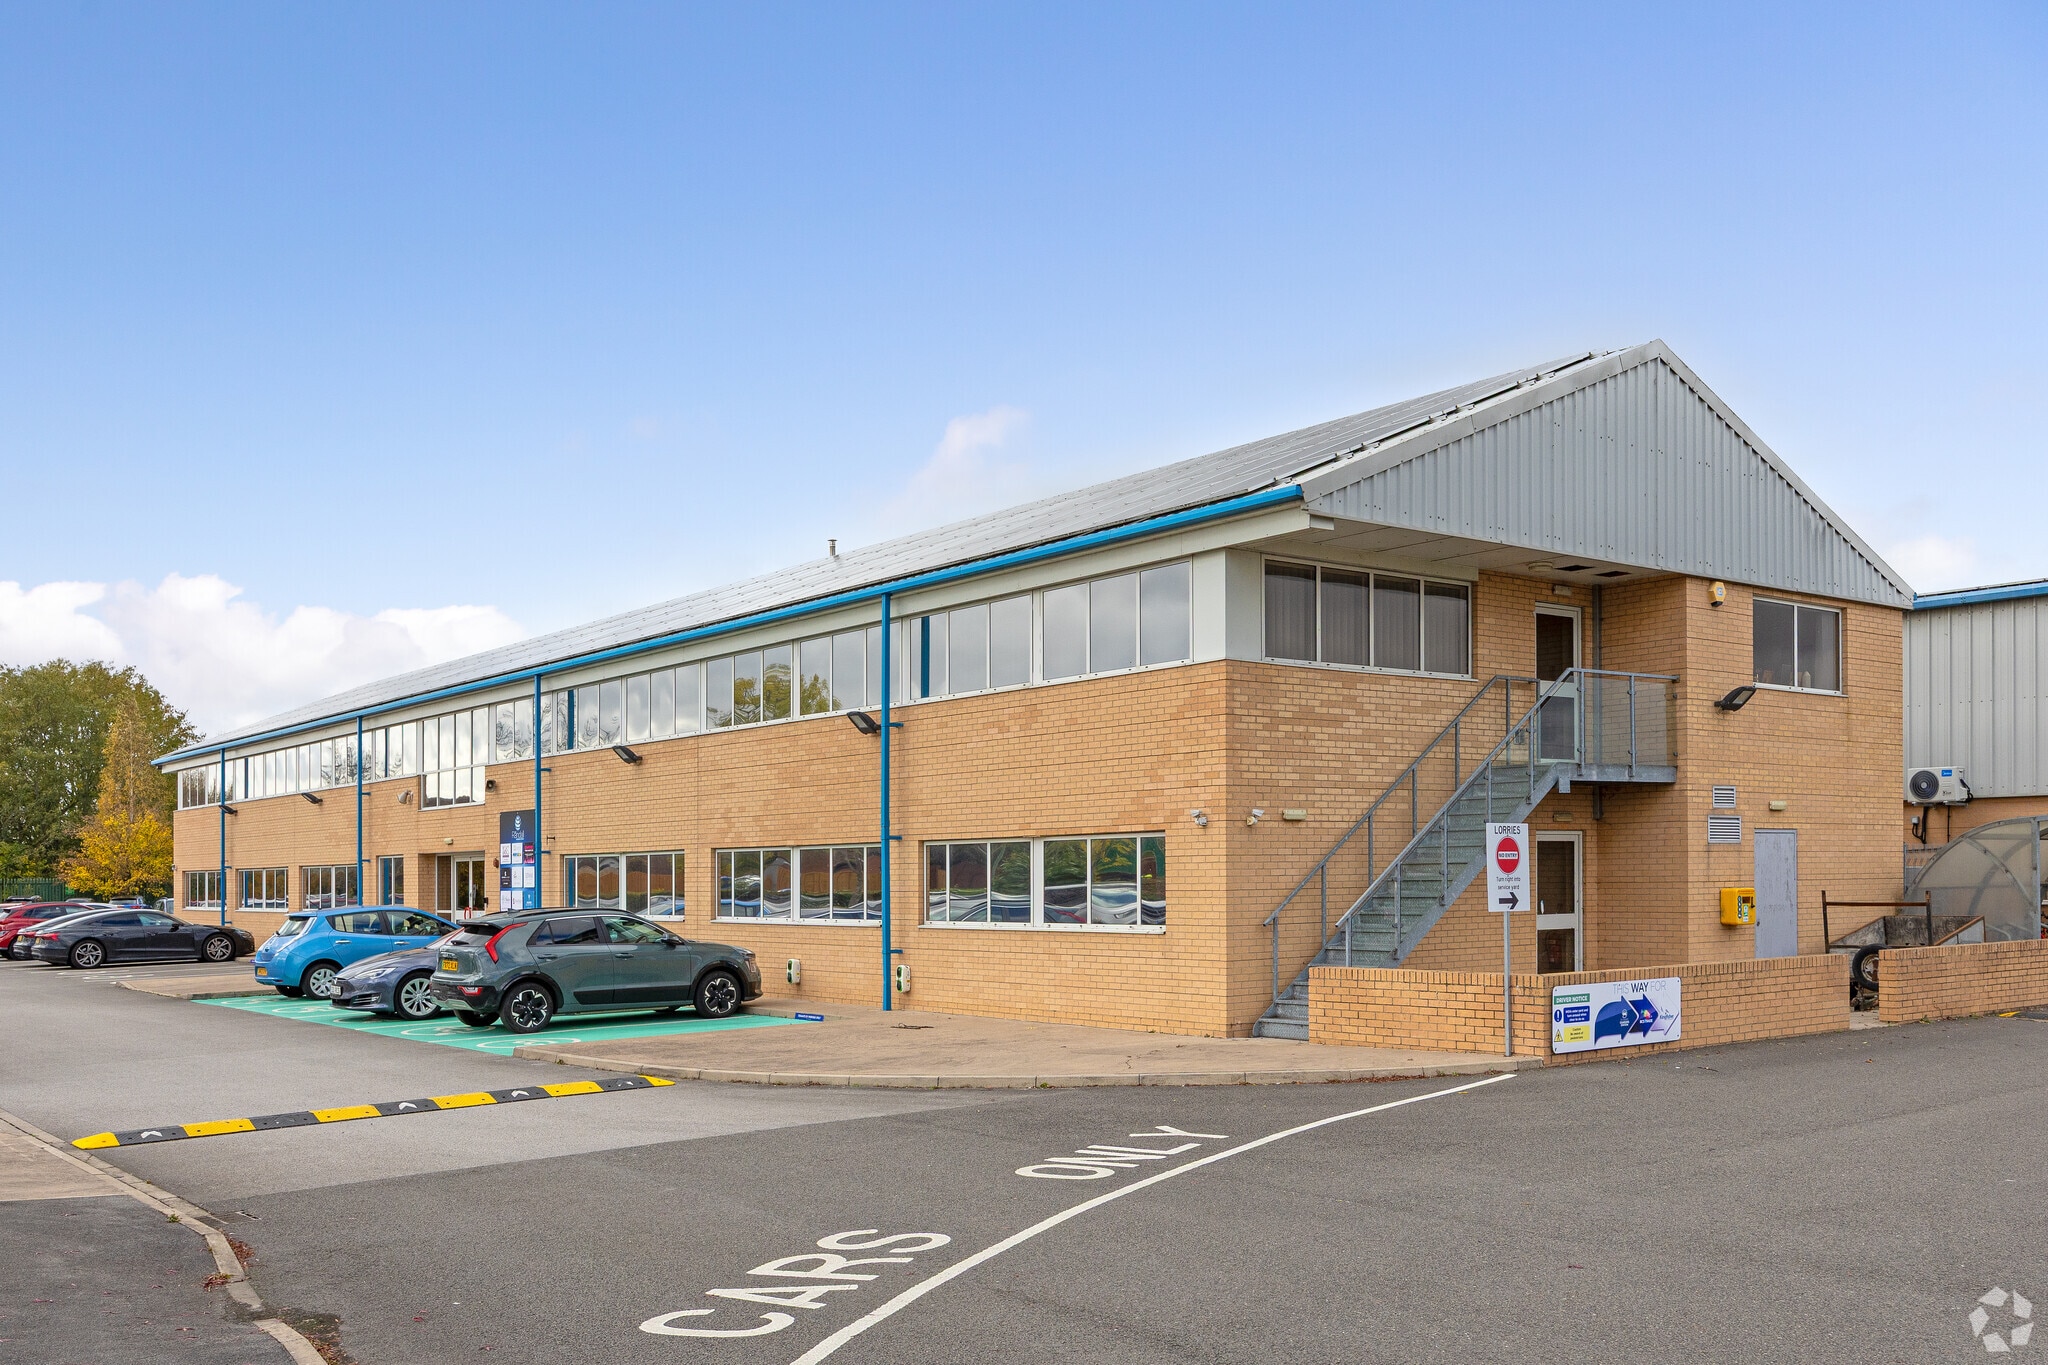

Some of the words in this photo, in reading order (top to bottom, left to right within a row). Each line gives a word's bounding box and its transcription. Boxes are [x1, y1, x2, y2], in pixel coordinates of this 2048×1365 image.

[1494, 826, 1521, 834] LORRIES
[1613, 983, 1629, 994] THIS
[1631, 982, 1648, 993] WAY
[1650, 980, 1666, 992] FOR
[1015, 1125, 1229, 1180] ONLY
[639, 1228, 952, 1339] CARS
